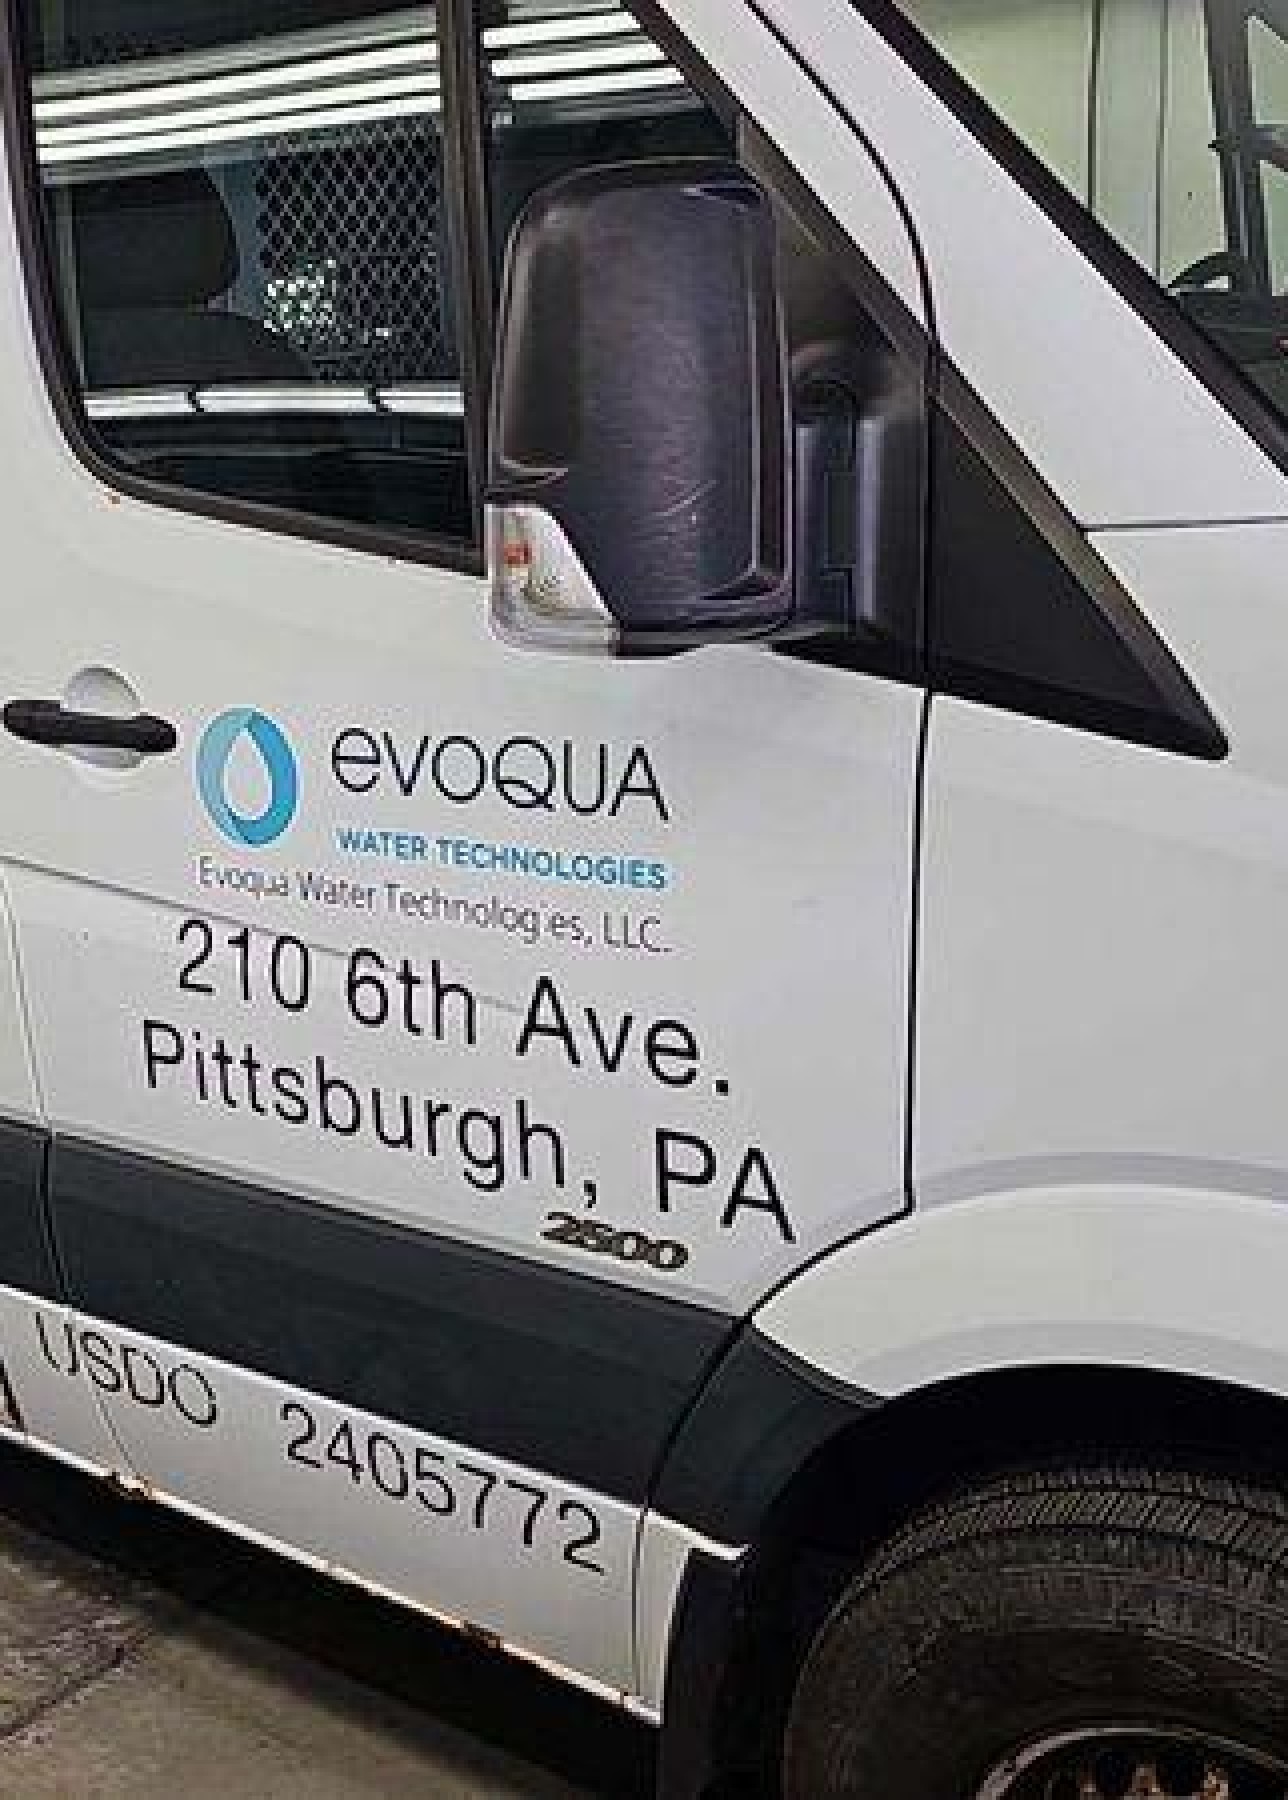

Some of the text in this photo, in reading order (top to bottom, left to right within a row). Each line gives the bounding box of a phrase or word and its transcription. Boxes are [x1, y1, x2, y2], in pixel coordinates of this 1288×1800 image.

[198, 861, 672, 953] Evoqua Water Technologes, LLC.
[336, 827, 666, 890] WATER TECHNOLOGIES
[178, 918, 729, 1096] 210 6th Ave.
[142, 1018, 796, 1244] Pittsburgh, PA
[541, 1211, 689, 1269] 2500
[279, 1402, 607, 1575] 2405772
